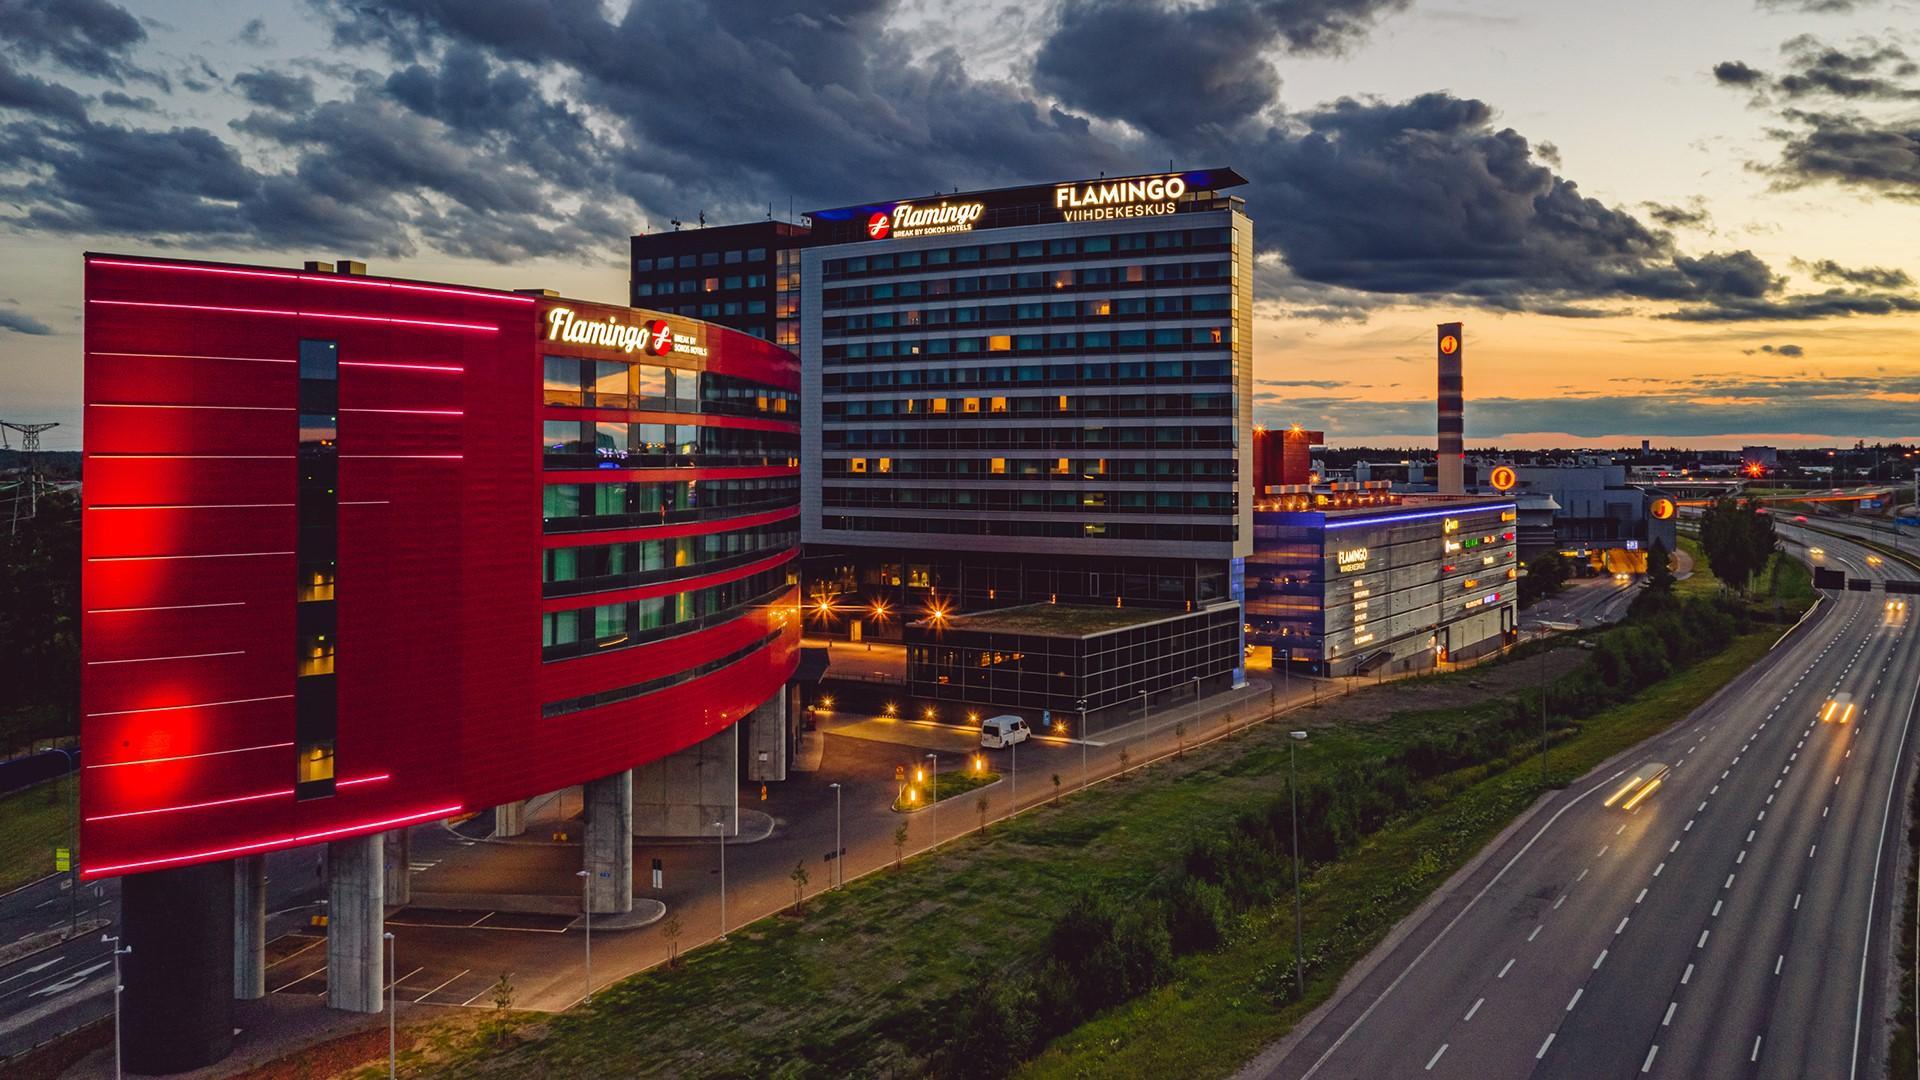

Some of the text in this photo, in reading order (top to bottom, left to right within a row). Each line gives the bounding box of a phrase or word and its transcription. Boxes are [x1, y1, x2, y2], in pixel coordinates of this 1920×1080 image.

[1056, 177, 1185, 208] FLAMINGO
[893, 201, 984, 225] Flamingo
[1064, 202, 1176, 222] VIIHDEKESKUS
[893, 223, 972, 238] BREAK BY SOKOS HOTELS
[549, 307, 650, 353] Flamingo
